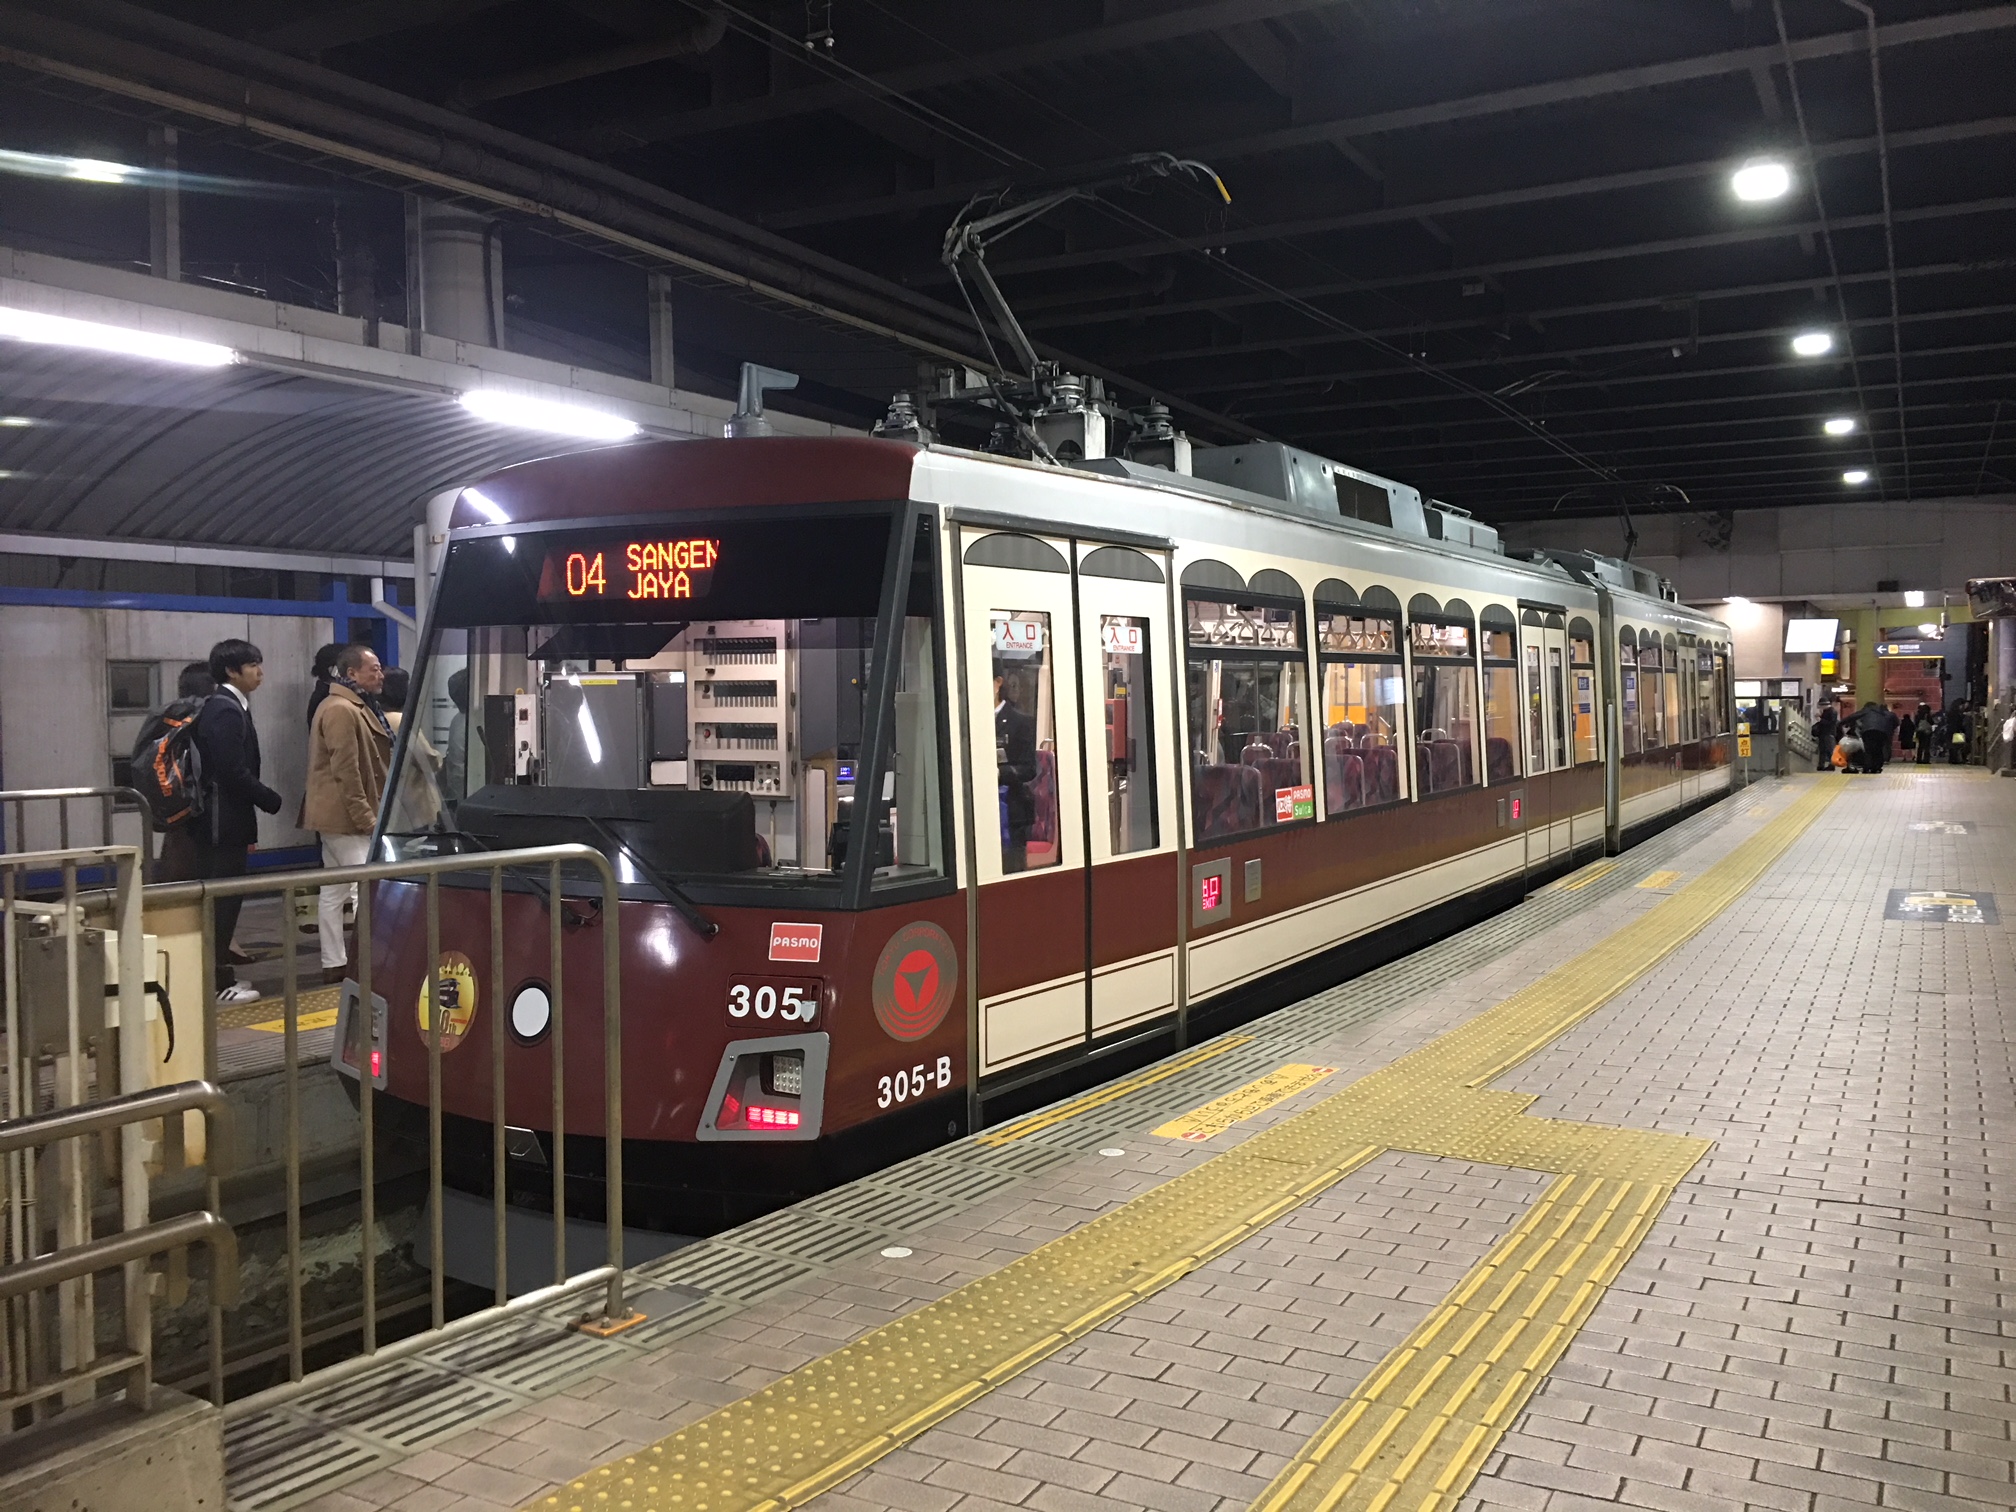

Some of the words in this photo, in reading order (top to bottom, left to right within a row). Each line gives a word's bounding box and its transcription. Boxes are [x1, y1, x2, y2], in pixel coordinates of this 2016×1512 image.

[626, 539, 720, 571] SANGEN
[566, 552, 607, 596] 04
[627, 571, 690, 599] JAYA
[1002, 622, 1036, 641] 入口
[1110, 627, 1137, 644] 入口
[1006, 641, 1033, 650] ENTRANCE
[1113, 644, 1135, 652] ENTRANCE
[1293, 788, 1311, 800] PASMO
[1294, 804, 1312, 816] Suica
[772, 936, 819, 949] PASMO
[728, 984, 804, 1020] 305
[877, 1055, 952, 1109] 305-B
